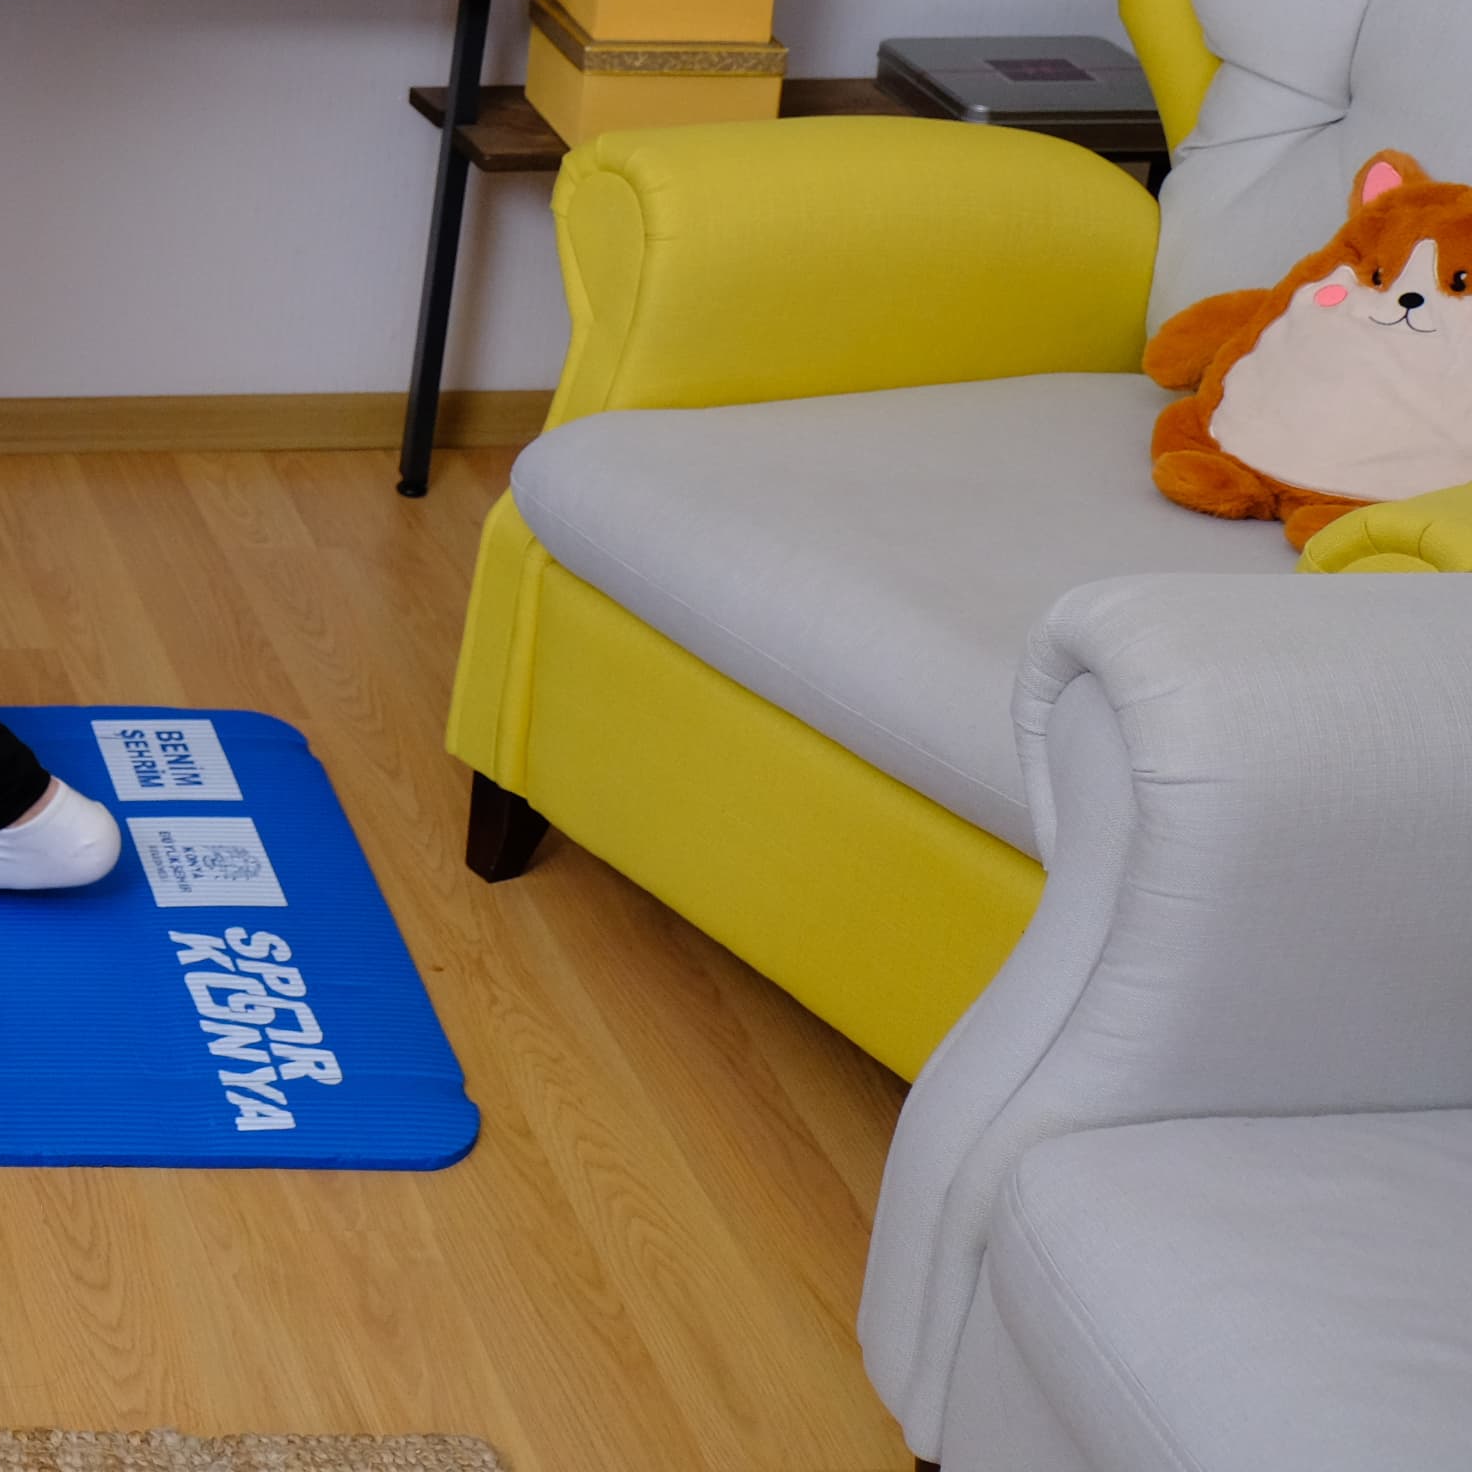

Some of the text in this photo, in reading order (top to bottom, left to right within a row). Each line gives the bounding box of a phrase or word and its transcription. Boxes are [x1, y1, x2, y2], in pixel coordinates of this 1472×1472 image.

[114, 729, 164, 789] ŞEHRİM
[155, 730, 204, 788] BENİM
[167, 930, 296, 1132] KONYA
[224, 926, 343, 1086] SPOR
